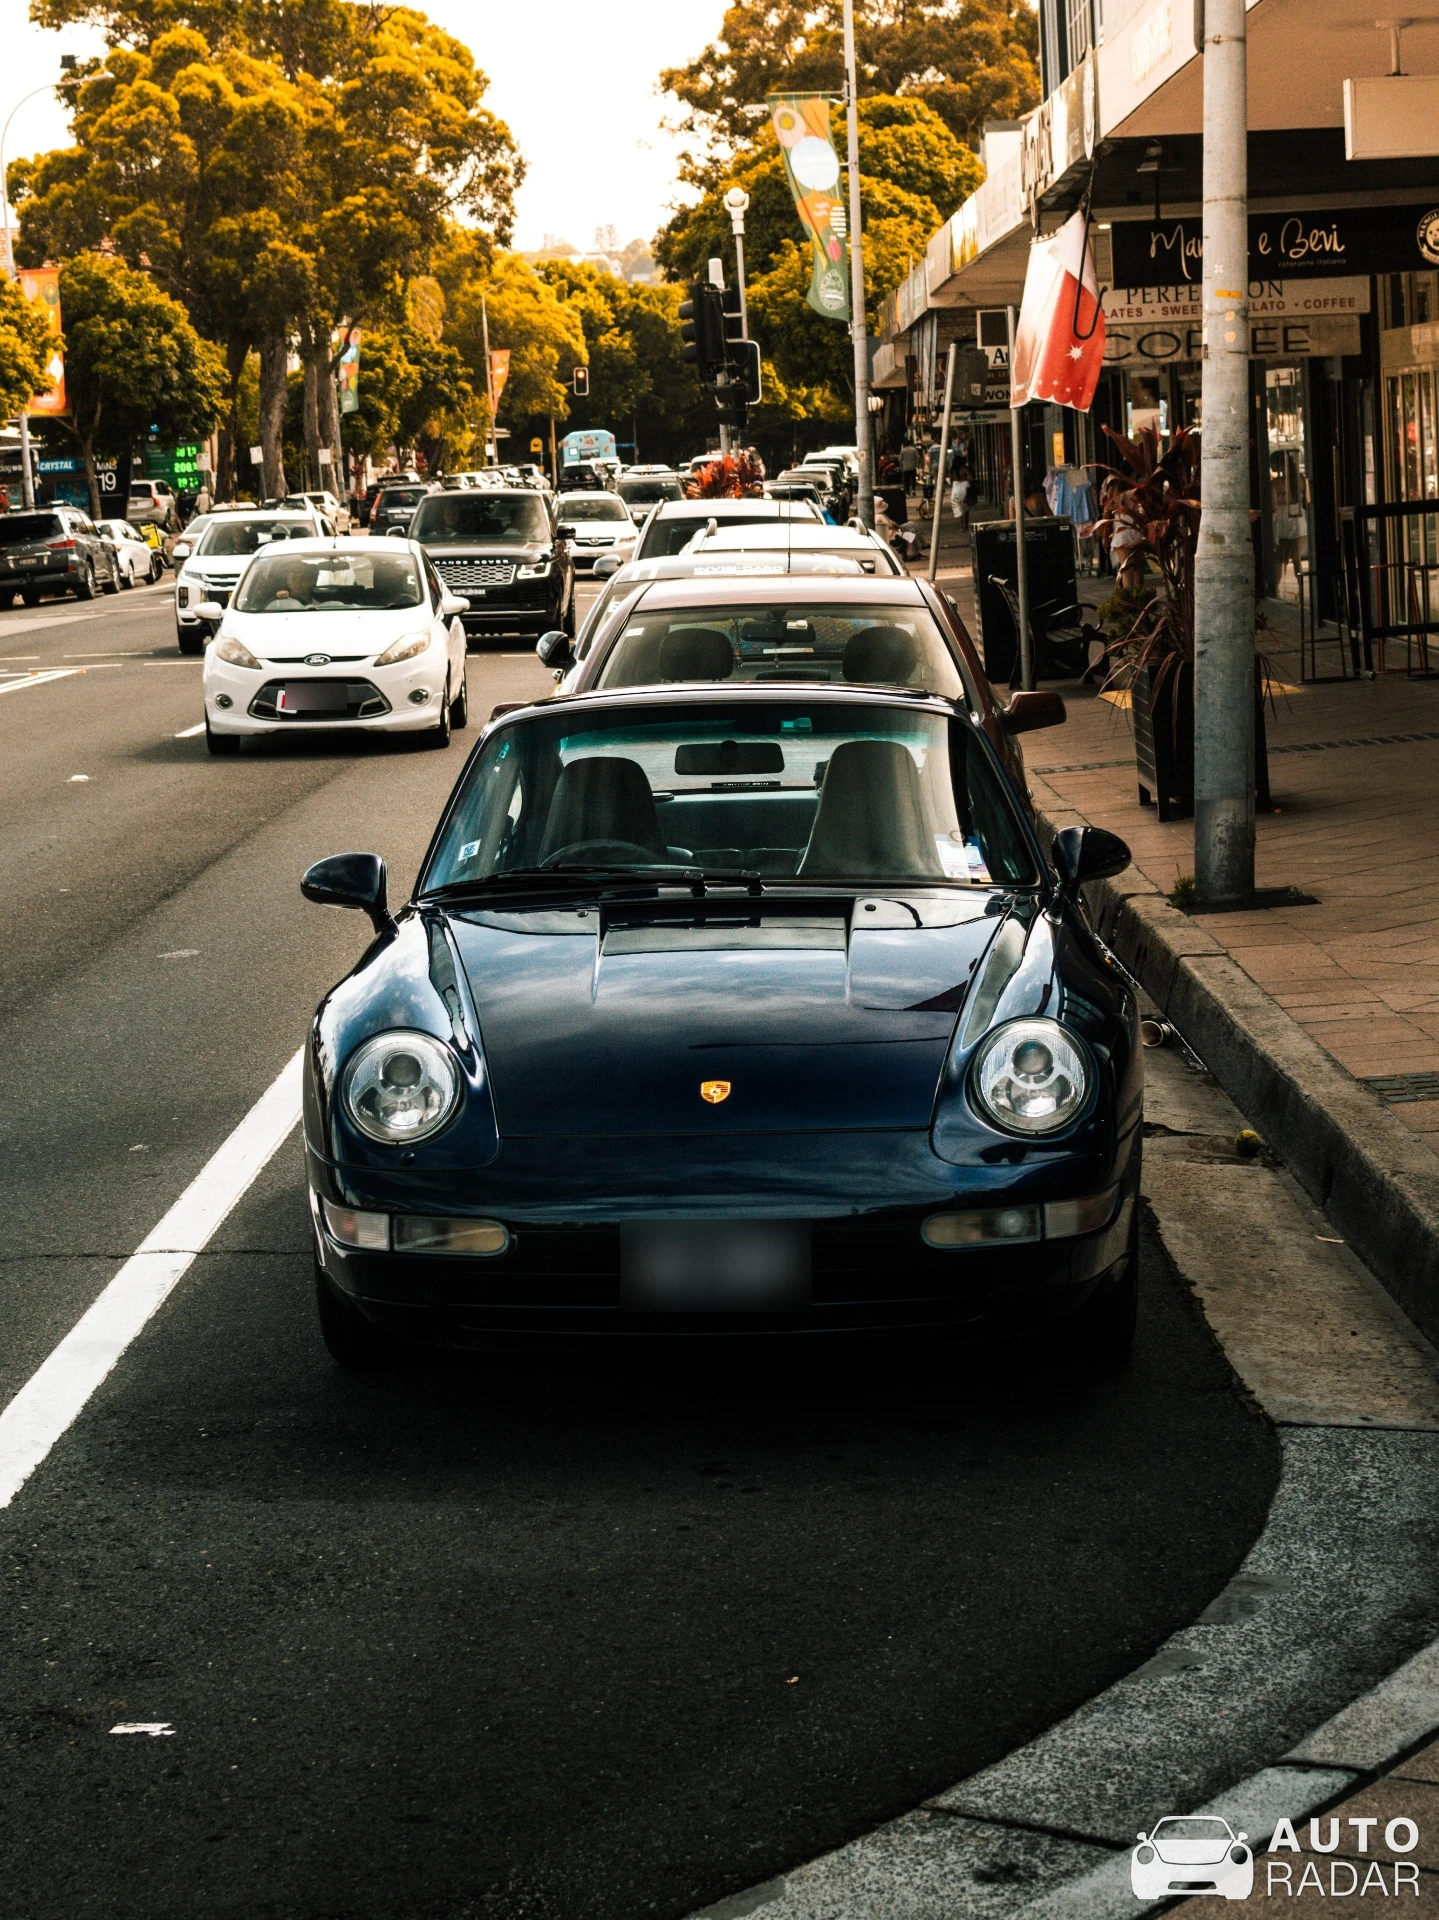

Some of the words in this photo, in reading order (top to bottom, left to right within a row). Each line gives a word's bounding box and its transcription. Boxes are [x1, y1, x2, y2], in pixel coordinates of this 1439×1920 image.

[1258, 232, 1272, 255] e
[1280, 217, 1345, 259] Bevi
[1126, 280, 1284, 304] PERFEON
[1161, 304, 1203, 315] SWEE
[1247, 301, 1285, 312] LATO
[1303, 297, 1356, 310] COFFEE
[1102, 324, 1310, 361] COFEE
[40, 461, 73, 471] CRYSTAL
